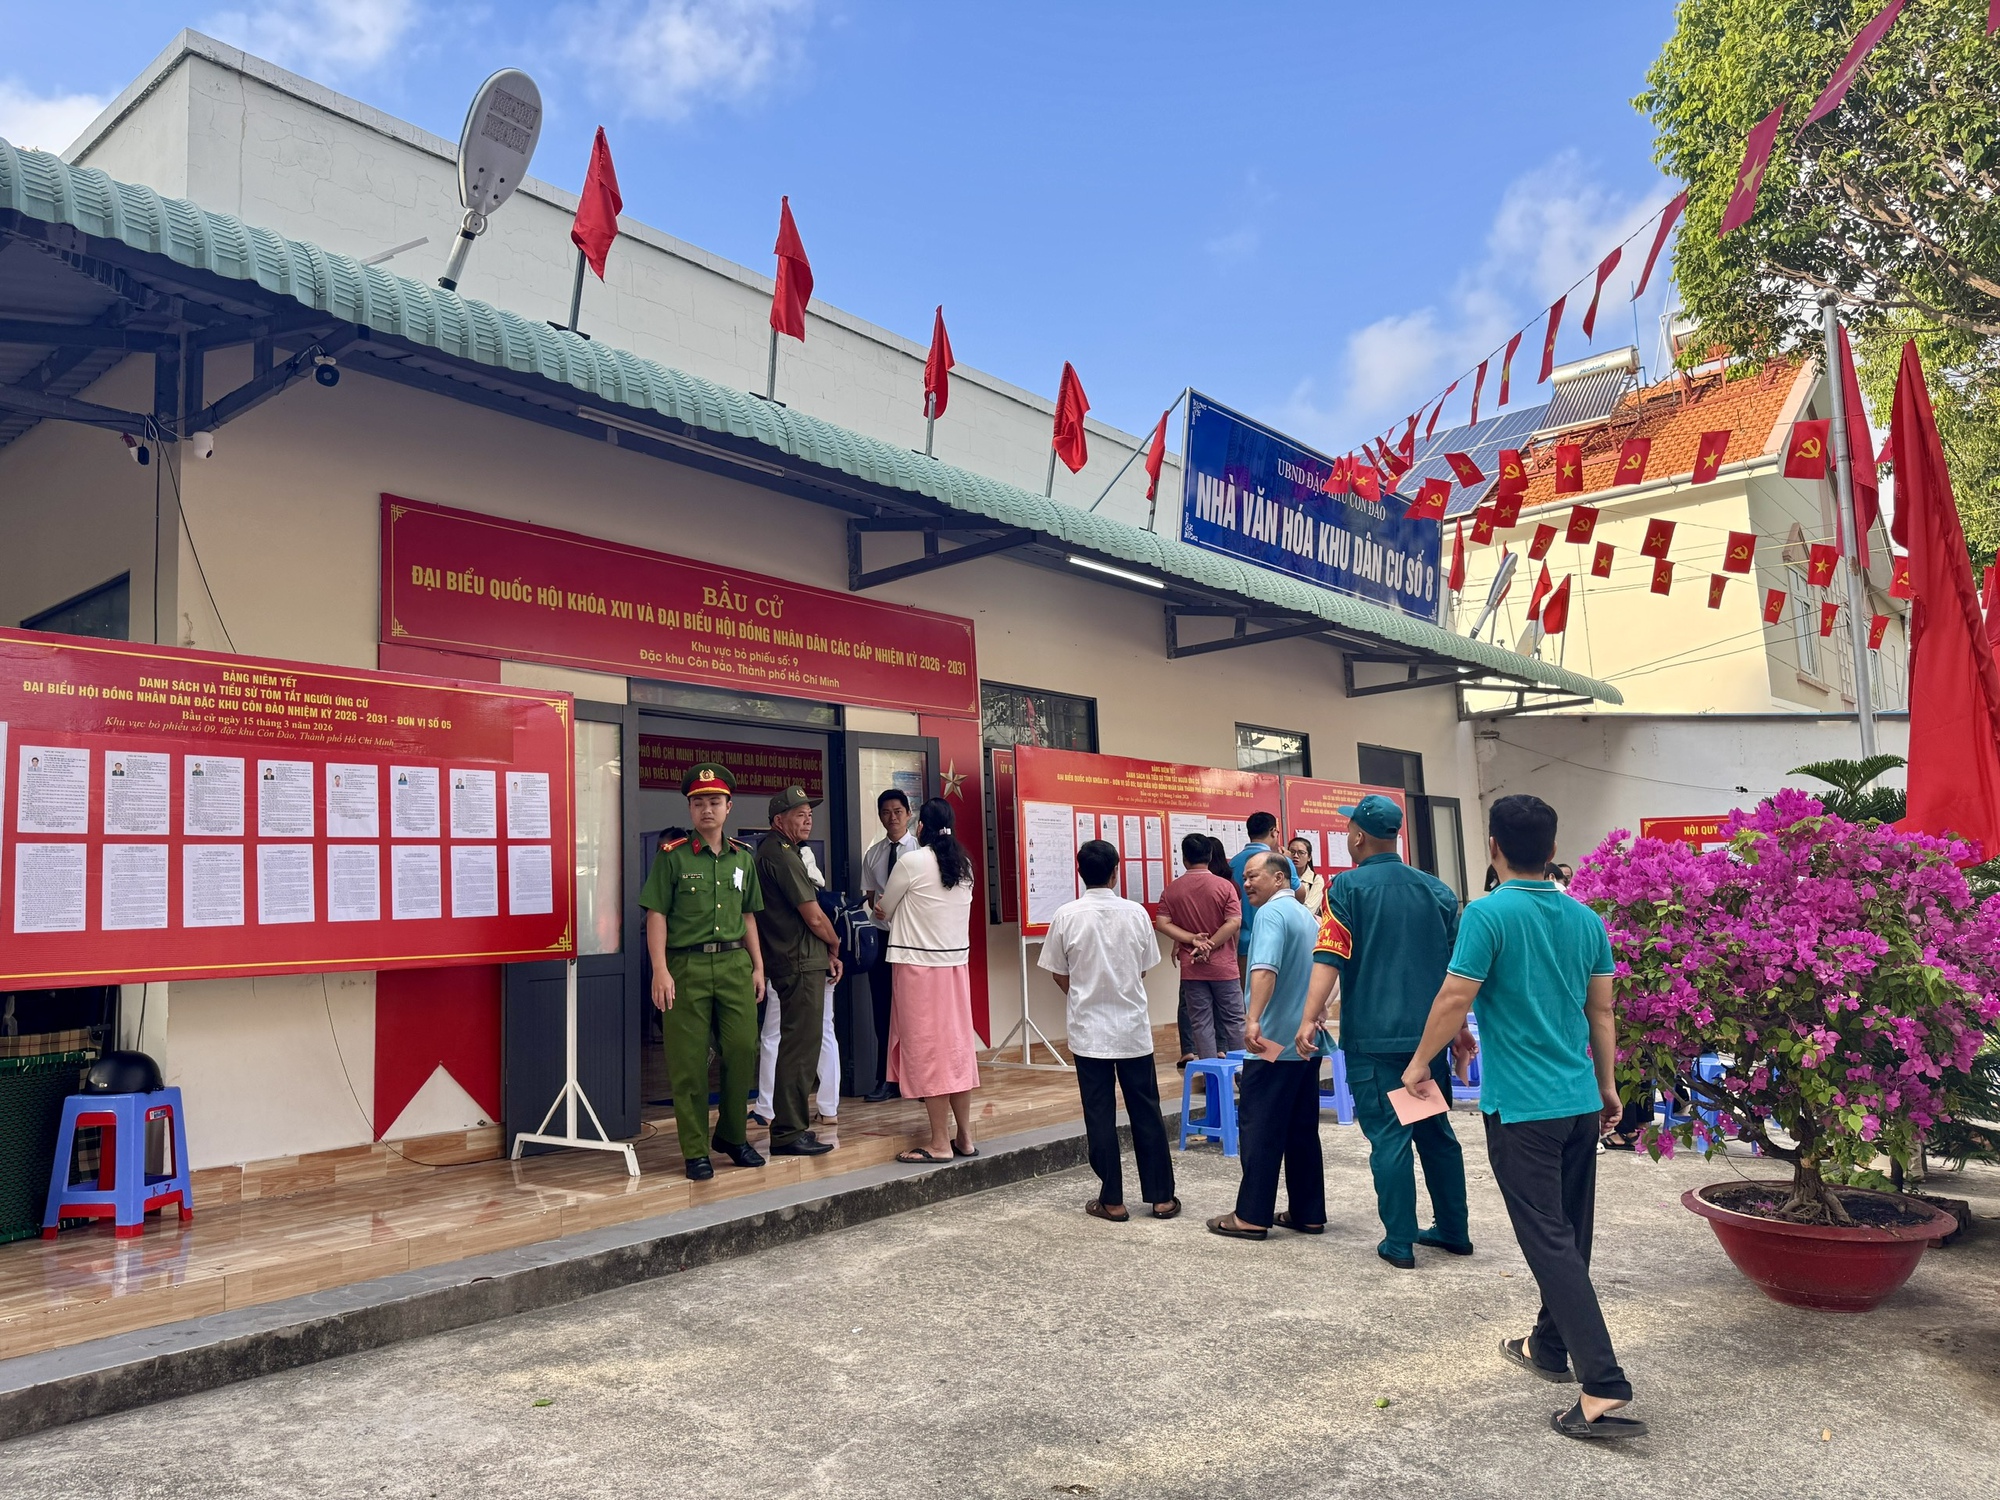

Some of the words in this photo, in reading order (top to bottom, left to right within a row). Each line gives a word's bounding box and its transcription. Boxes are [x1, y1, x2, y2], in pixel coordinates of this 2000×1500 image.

[1277, 458, 1306, 485] UBND
[1195, 472, 1236, 531] NHÀ
[1243, 485, 1279, 546] VĂN
[1281, 504, 1313, 559] HÓA
[1318, 522, 1351, 571] KHU
[1352, 532, 1383, 584] DÂN
[1385, 548, 1406, 591] CƯ
[1405, 550, 1425, 598] SỐ
[1425, 566, 1434, 602] 8
[702, 580, 748, 612] BẦU
[755, 594, 784, 619] CỬ
[411, 565, 441, 591] ĐẠI
[446, 567, 484, 595] BIỂU
[490, 576, 532, 603] QUỐC
[537, 585, 563, 611] HỘI
[568, 592, 607, 616] KHÓA
[610, 600, 633, 620] XVI
[636, 602, 655, 623] VÀ
[658, 608, 680, 630] ĐẠI
[684, 610, 712, 633] BIỂU
[716, 616, 736, 640] HỘI
[738, 619, 770, 643] ĐỒNG
[773, 629, 804, 649] NHÂN
[806, 633, 828, 653] DÂN
[830, 638, 851, 657] CÁC
[853, 640, 873, 660] CẤP
[875, 647, 905, 667] NHIỆM
[906, 651, 918, 668] KỲ
[920, 655, 940, 672] 2026
[948, 659, 966, 676] 2031
[639, 649, 662, 664] Đặc
[666, 652, 685, 665] khu
[687, 656, 709, 668] Côn
[711, 657, 735, 673] Đảo.
[737, 661, 766, 677] Thành
[768, 668, 787, 680] phố
[788, 670, 801, 682] Hồ
[802, 673, 818, 685] Chí
[820, 676, 840, 688] Minh
[691, 641, 711, 654] Khu
[713, 646, 732, 658] vực
[734, 648, 747, 660] bỏ
[749, 651, 776, 664] phiếu
[778, 654, 791, 666] số:
[792, 657, 799, 667] 9
[139, 677, 169, 690] DANH
[172, 679, 200, 692] SÁCH
[203, 682, 216, 694] VÀ
[219, 684, 242, 697] TIỂU
[244, 686, 258, 698] SỬ
[260, 688, 282, 700] TÓM
[284, 689, 302, 702] TẮT
[304, 693, 332, 705] NGƯỜI
[335, 694, 354, 707] ỨNG
[356, 696, 369, 708] CỬ
[223, 670, 250, 684] BẢNG
[252, 673, 277, 686] NIÊM
[280, 675, 298, 688] YẾT
[22, 680, 44, 694] ĐẠI
[48, 682, 75, 696] BIỂU
[78, 685, 99, 699] HỘI
[102, 687, 134, 701] ĐỒNG
[137, 691, 167, 704] NHÂN
[170, 693, 191, 706] DÂN
[194, 696, 215, 710] ĐẶC
[218, 699, 239, 710] KHU
[242, 700, 262, 712] CÔN
[265, 702, 285, 715] ĐẢO
[288, 705, 318, 719] NHIỆM
[321, 707, 332, 719] KỲ
[334, 710, 358, 721] 2026
[366, 712, 388, 724] 2031
[396, 715, 415, 726] ĐƠN
[417, 718, 426, 729] VỊ
[428, 716, 440, 728] SỐ
[441, 720, 452, 730] 05
[105, 716, 126, 729] Khu
[129, 720, 146, 728] vực
[148, 720, 161, 729] bỏ
[162, 721, 189, 732] phiếu
[190, 722, 202, 732] số
[220, 724, 238, 736] đặc
[238, 727, 255, 736] khu
[257, 728, 275, 738] Côn
[276, 728, 297, 740] Đảo,
[300, 732, 325, 741] Thành
[326, 733, 342, 744] phố
[344, 734, 357, 744] Hồ
[358, 736, 373, 745] Chí
[374, 737, 394, 748] Minh
[182, 710, 202, 724] Bầu
[204, 713, 216, 722] cử
[218, 715, 241, 726] ngày
[244, 716, 254, 725] 15
[256, 718, 282, 729] tháng
[284, 720, 290, 728] 3
[292, 721, 311, 730] năm
[313, 722, 334, 732] 2026
[663, 745, 675, 760] CHÍ
[676, 747, 694, 762] MINH
[695, 748, 710, 763] TÍCH
[710, 750, 724, 765] CỰC
[725, 752, 743, 765] THAM
[744, 753, 754, 766] GIA
[778, 756, 788, 771] ĐẠI
[640, 766, 652, 782] ĐẠI
[763, 773, 782, 790] NHIỆM
[1684, 824, 1699, 837] NỘI
[1701, 825, 1718, 836] QUY
